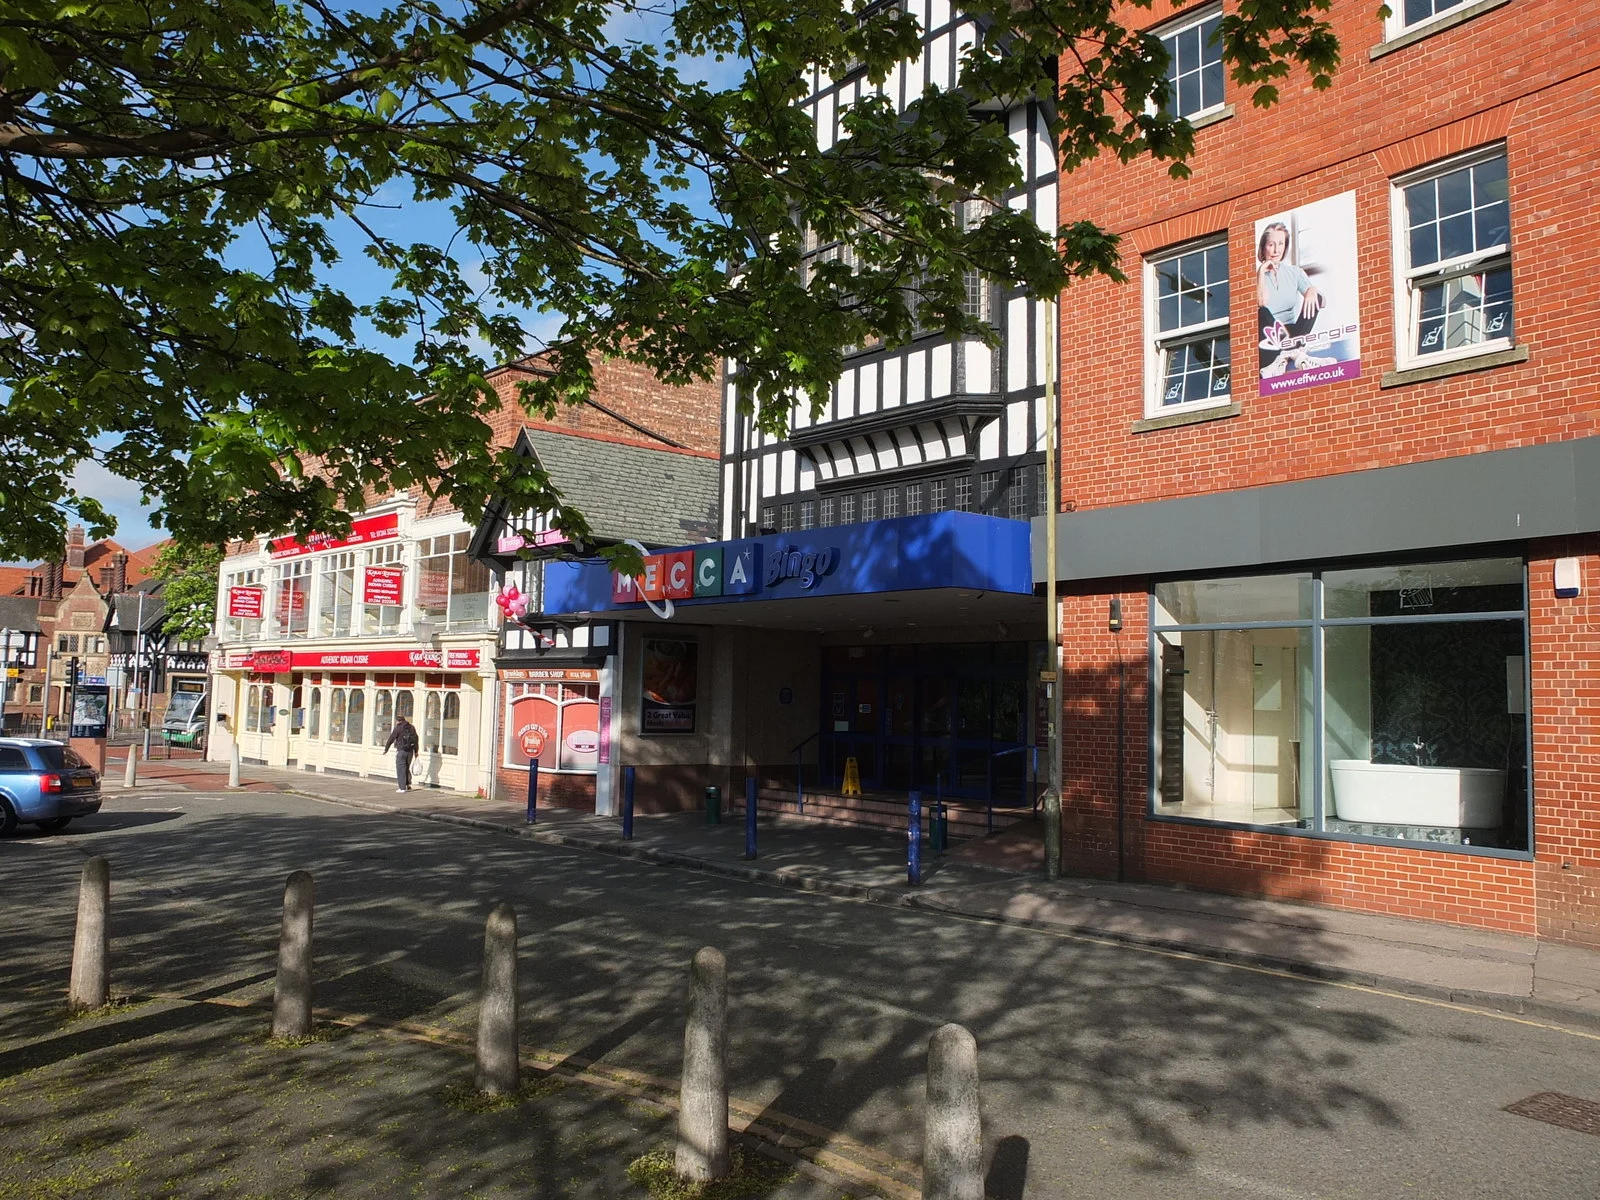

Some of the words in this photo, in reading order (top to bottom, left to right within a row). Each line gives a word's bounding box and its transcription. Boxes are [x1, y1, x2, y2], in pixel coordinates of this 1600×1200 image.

[1271, 366, 1345, 390] www.effw.co.uk
[617, 555, 747, 593] MECCA
[765, 545, 833, 589] Bingo
[320, 655, 340, 664] AUTHENTIC
[340, 655, 354, 664] INDIAN
[354, 654, 369, 664] CUISINE
[528, 670, 549, 678] BARBER
[550, 670, 564, 678] SHOP
[673, 711, 691, 719] Value
[530, 723, 539, 731] CUT
